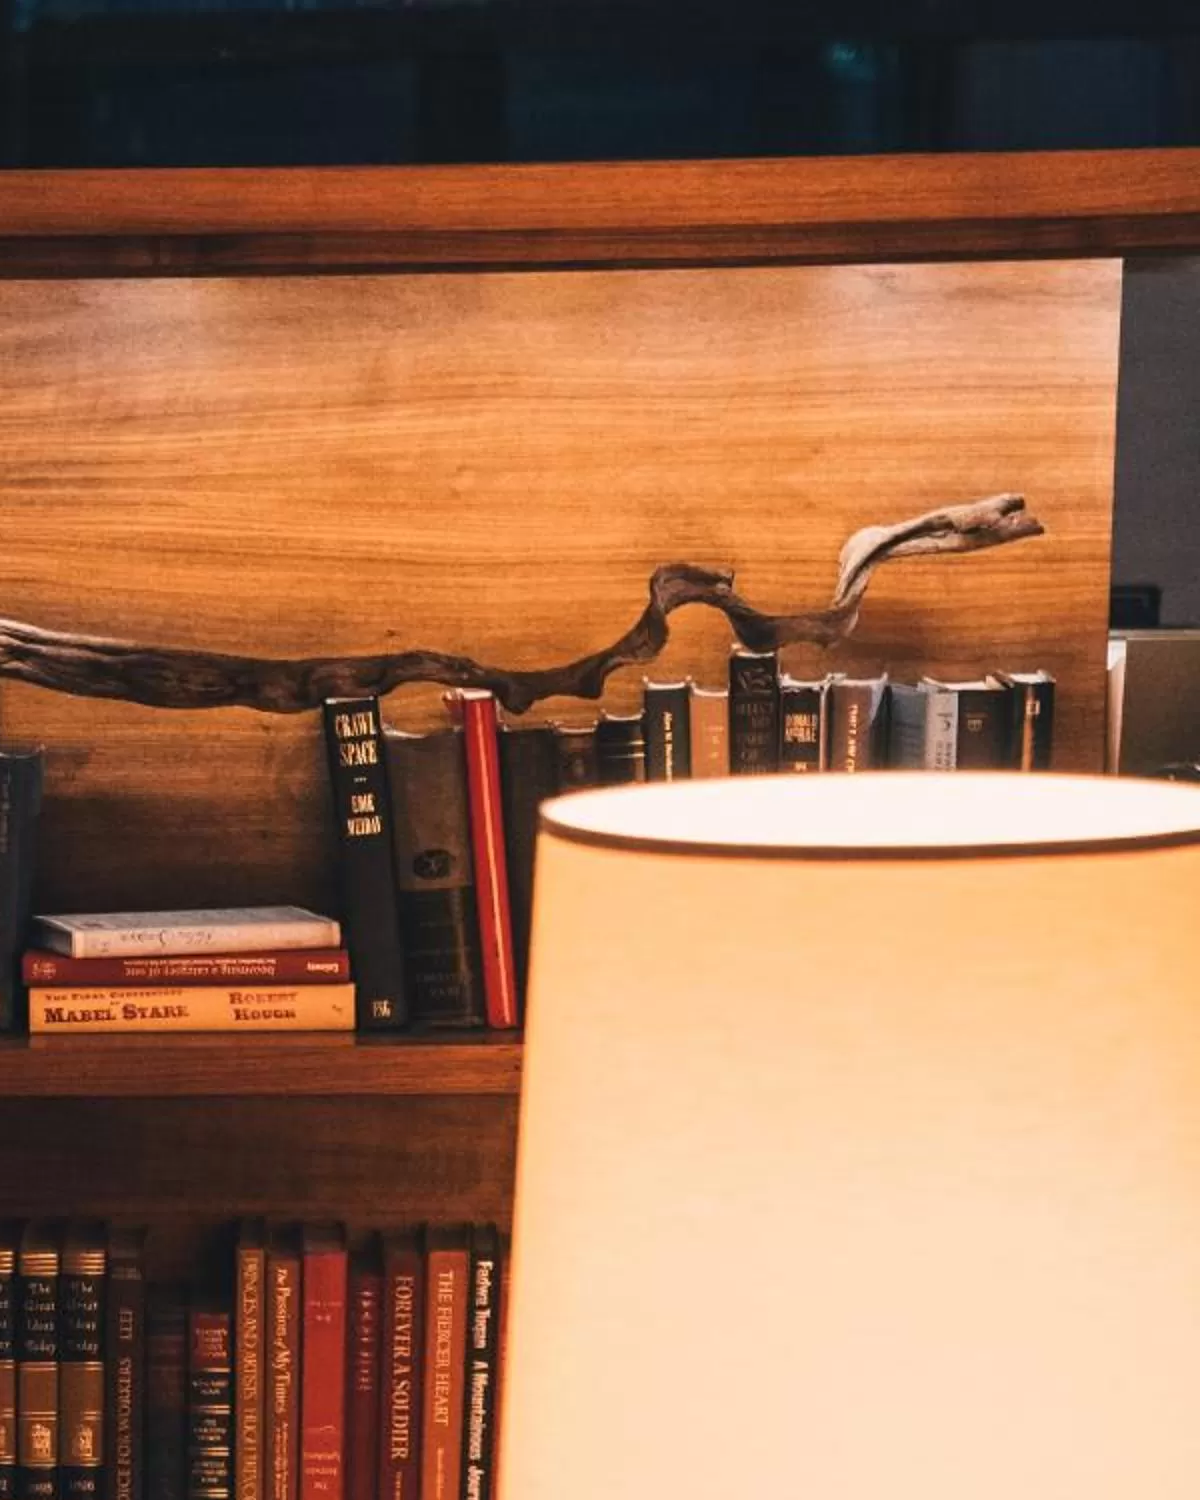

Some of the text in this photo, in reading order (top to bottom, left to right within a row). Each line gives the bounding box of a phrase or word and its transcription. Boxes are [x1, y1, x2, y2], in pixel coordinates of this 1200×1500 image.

[335, 711, 377, 737] CRAWL
[340, 740, 378, 766] SPACE
[229, 992, 298, 1005] ROBERT
[44, 1003, 189, 1024] MABEL STARK
[233, 1008, 297, 1020] HOUGH
[276, 1268, 288, 1285] The
[475, 1261, 493, 1306] Fadwa
[273, 1286, 291, 1336] Passion
[394, 1275, 414, 1359] FOREVER
[272, 1350, 290, 1371] My
[434, 1271, 453, 1427] THE FIERCER HEART
[243, 1352, 257, 1400] ARTISTS
[394, 1362, 410, 1375] A
[473, 1361, 488, 1370] A
[274, 1371, 290, 1414] Times
[390, 1380, 410, 1460] SOLDIER
[468, 1372, 488, 1460] Mountainous
